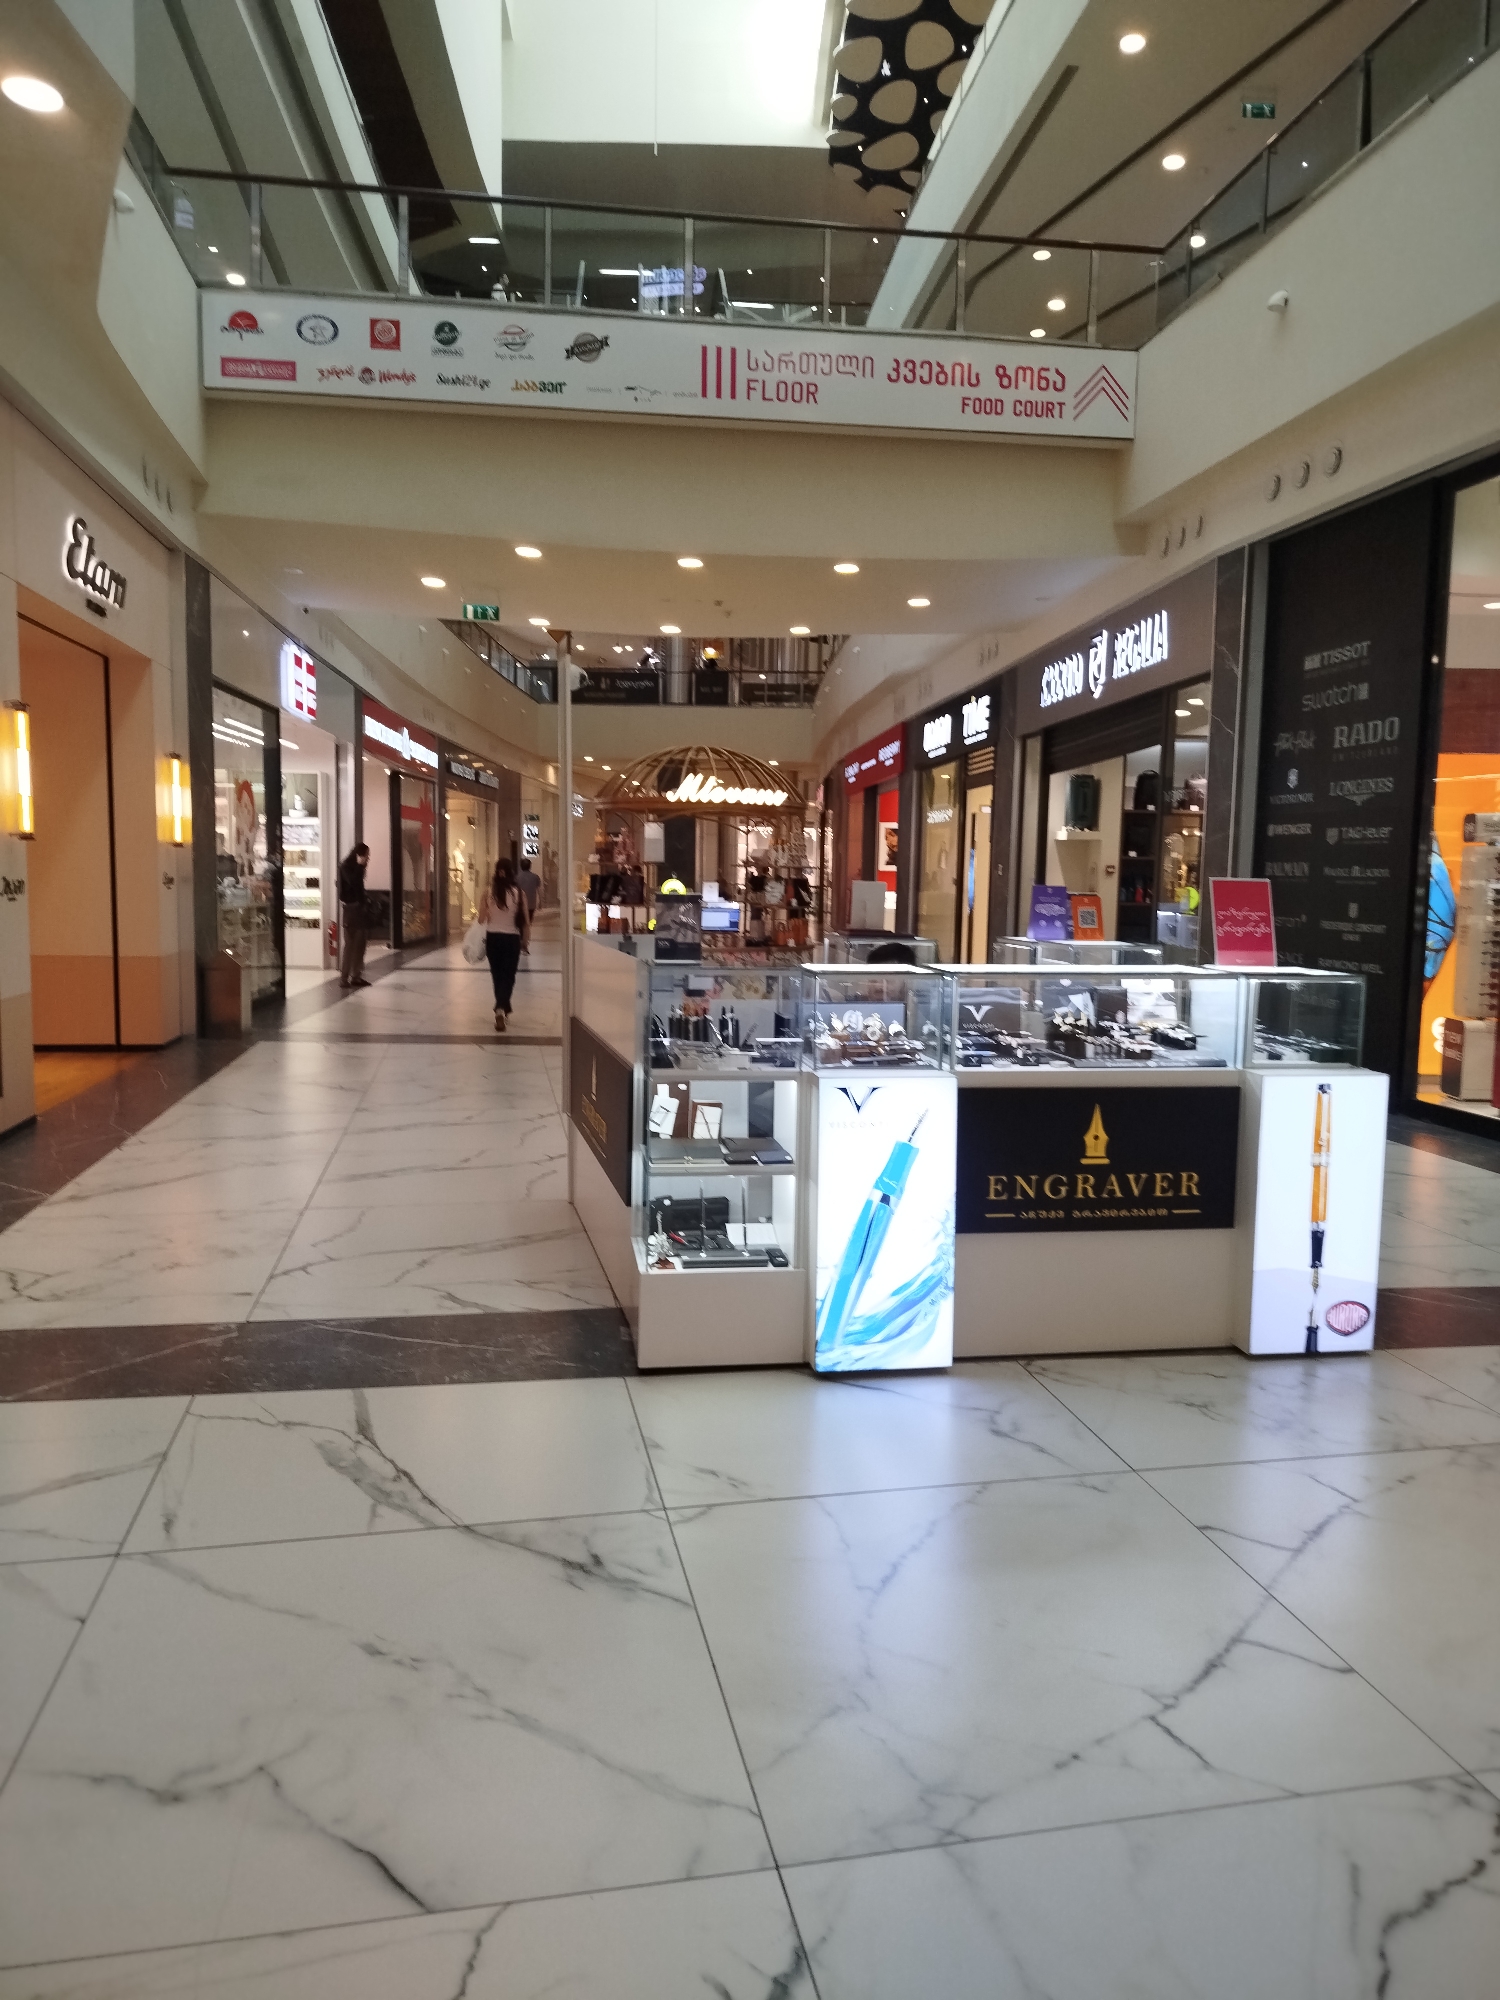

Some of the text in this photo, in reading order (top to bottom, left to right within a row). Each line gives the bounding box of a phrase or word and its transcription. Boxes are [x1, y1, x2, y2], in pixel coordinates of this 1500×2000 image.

[746, 348, 875, 380] სართული
[886, 357, 1067, 393] კვების ზონა
[746, 377, 819, 405] FLOOR
[960, 396, 1067, 419] FOOD COURT
[62, 515, 127, 610] Etam
[1321, 640, 1371, 666] TISSOT
[1302, 682, 1358, 712] swatch
[1332, 717, 1400, 749] RADO
[985, 1171, 1202, 1201] ENGRAVER
